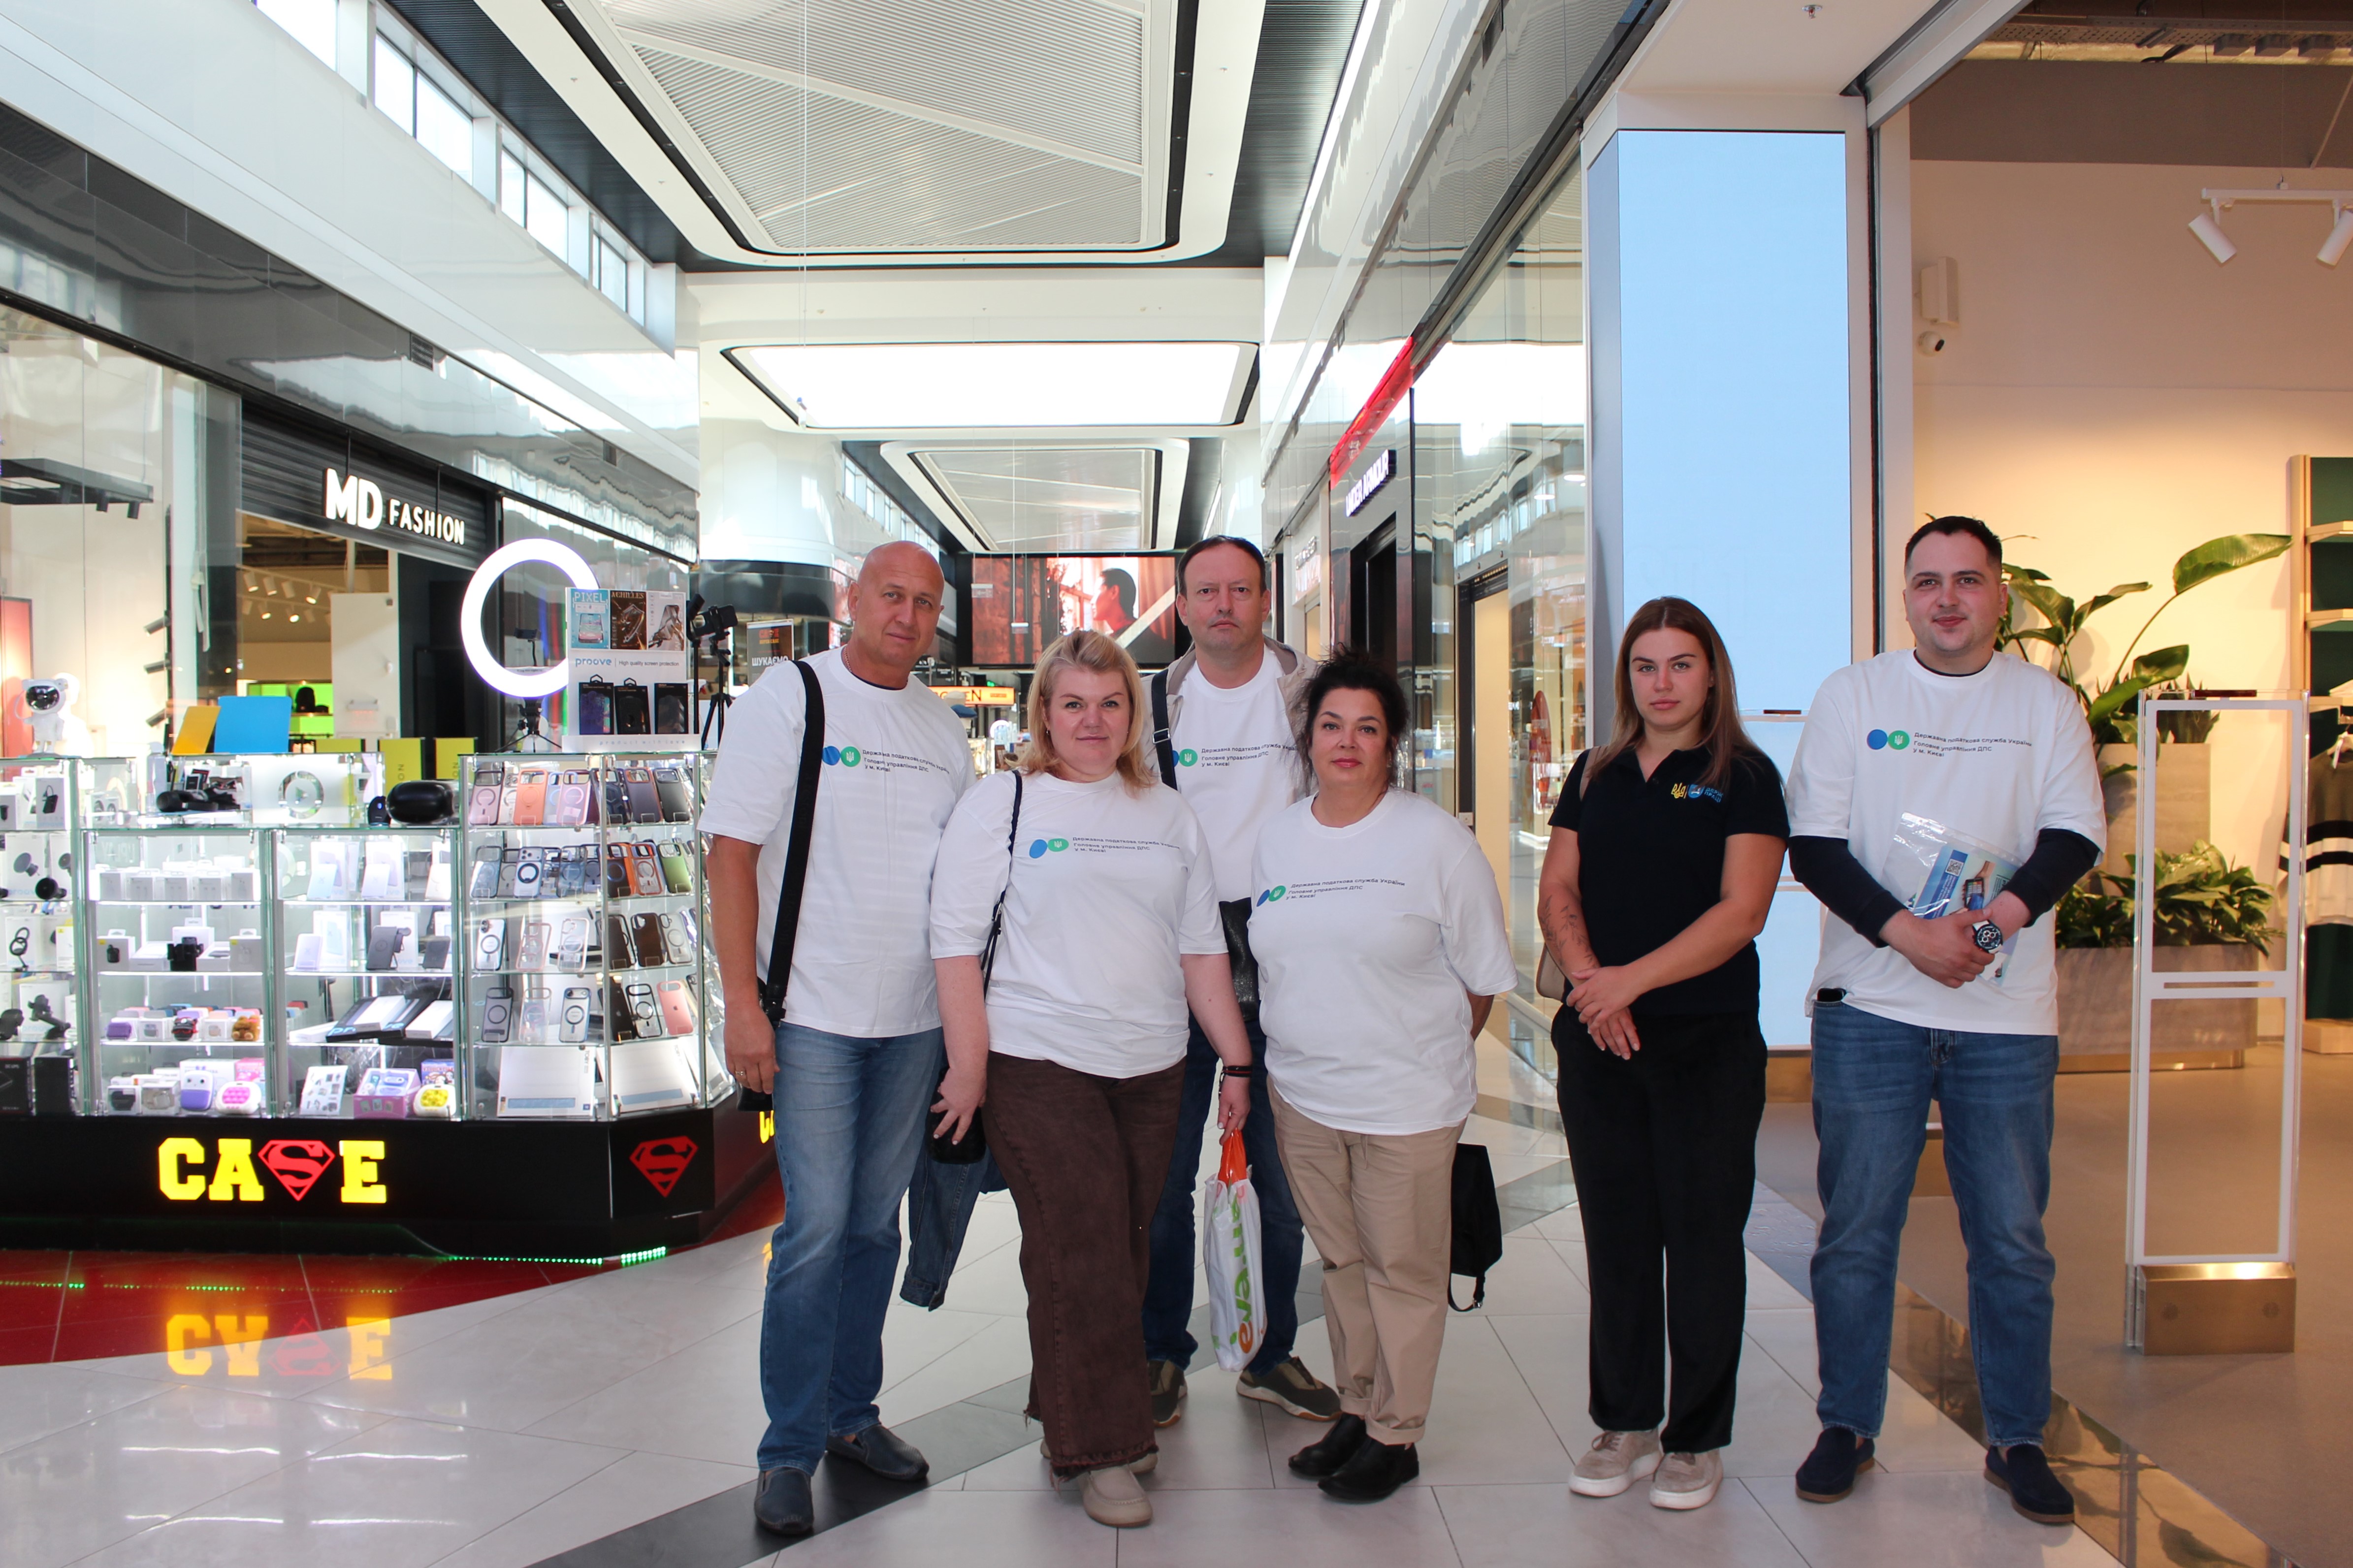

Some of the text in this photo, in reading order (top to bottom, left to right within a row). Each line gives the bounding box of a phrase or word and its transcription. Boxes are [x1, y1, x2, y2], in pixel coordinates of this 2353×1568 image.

[1363, 449, 1389, 500] ARMOUR
[325, 467, 465, 545] MD FASHION
[574, 592, 605, 603] PIXEL
[576, 658, 612, 667] proove
[1914, 732, 1946, 742] Державна
[1914, 741, 1940, 750] Головне
[886, 761, 918, 770] управління
[920, 758, 936, 768] служба
[1704, 791, 1721, 802] ПРАЦІ
[158, 1137, 387, 1203] CASE
